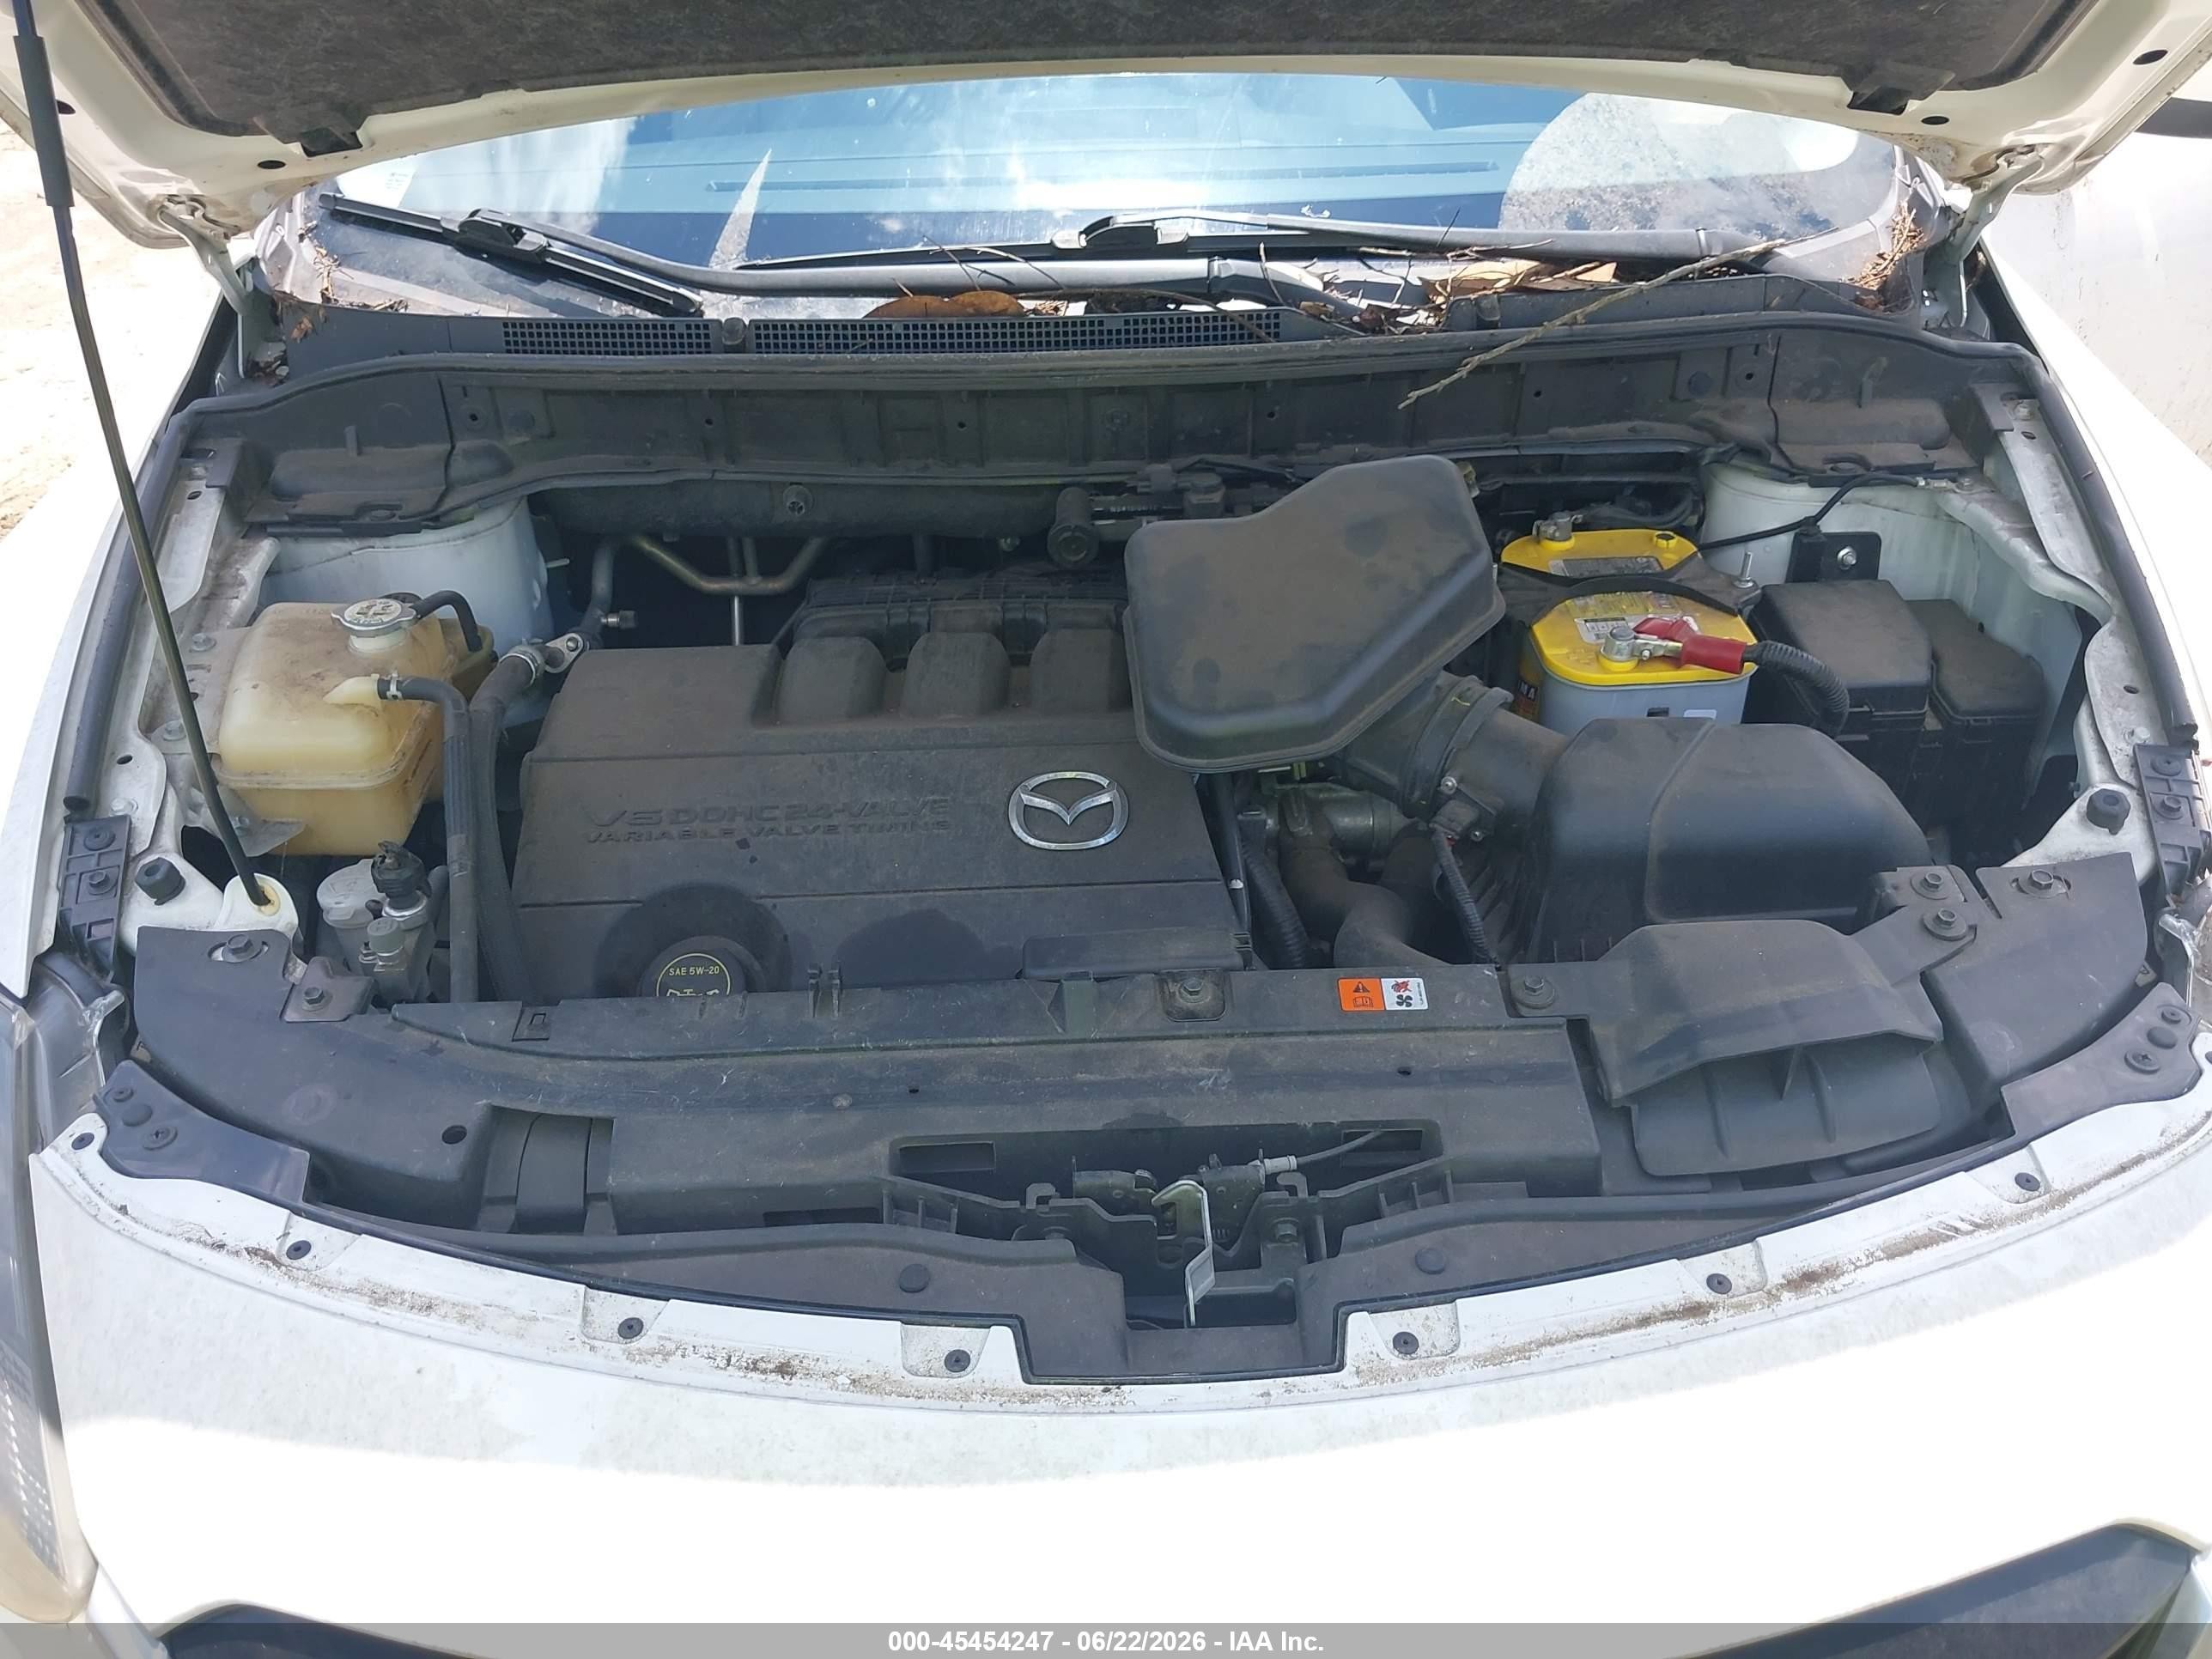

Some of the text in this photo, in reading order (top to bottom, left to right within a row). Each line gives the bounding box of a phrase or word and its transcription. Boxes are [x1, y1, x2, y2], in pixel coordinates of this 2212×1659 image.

[670, 804, 780, 824] DOHC
[785, 796, 950, 821] 24-VALVE
[587, 818, 950, 843] VARIABLE VALVE TIMING
[689, 965, 720, 975] 5W-20
